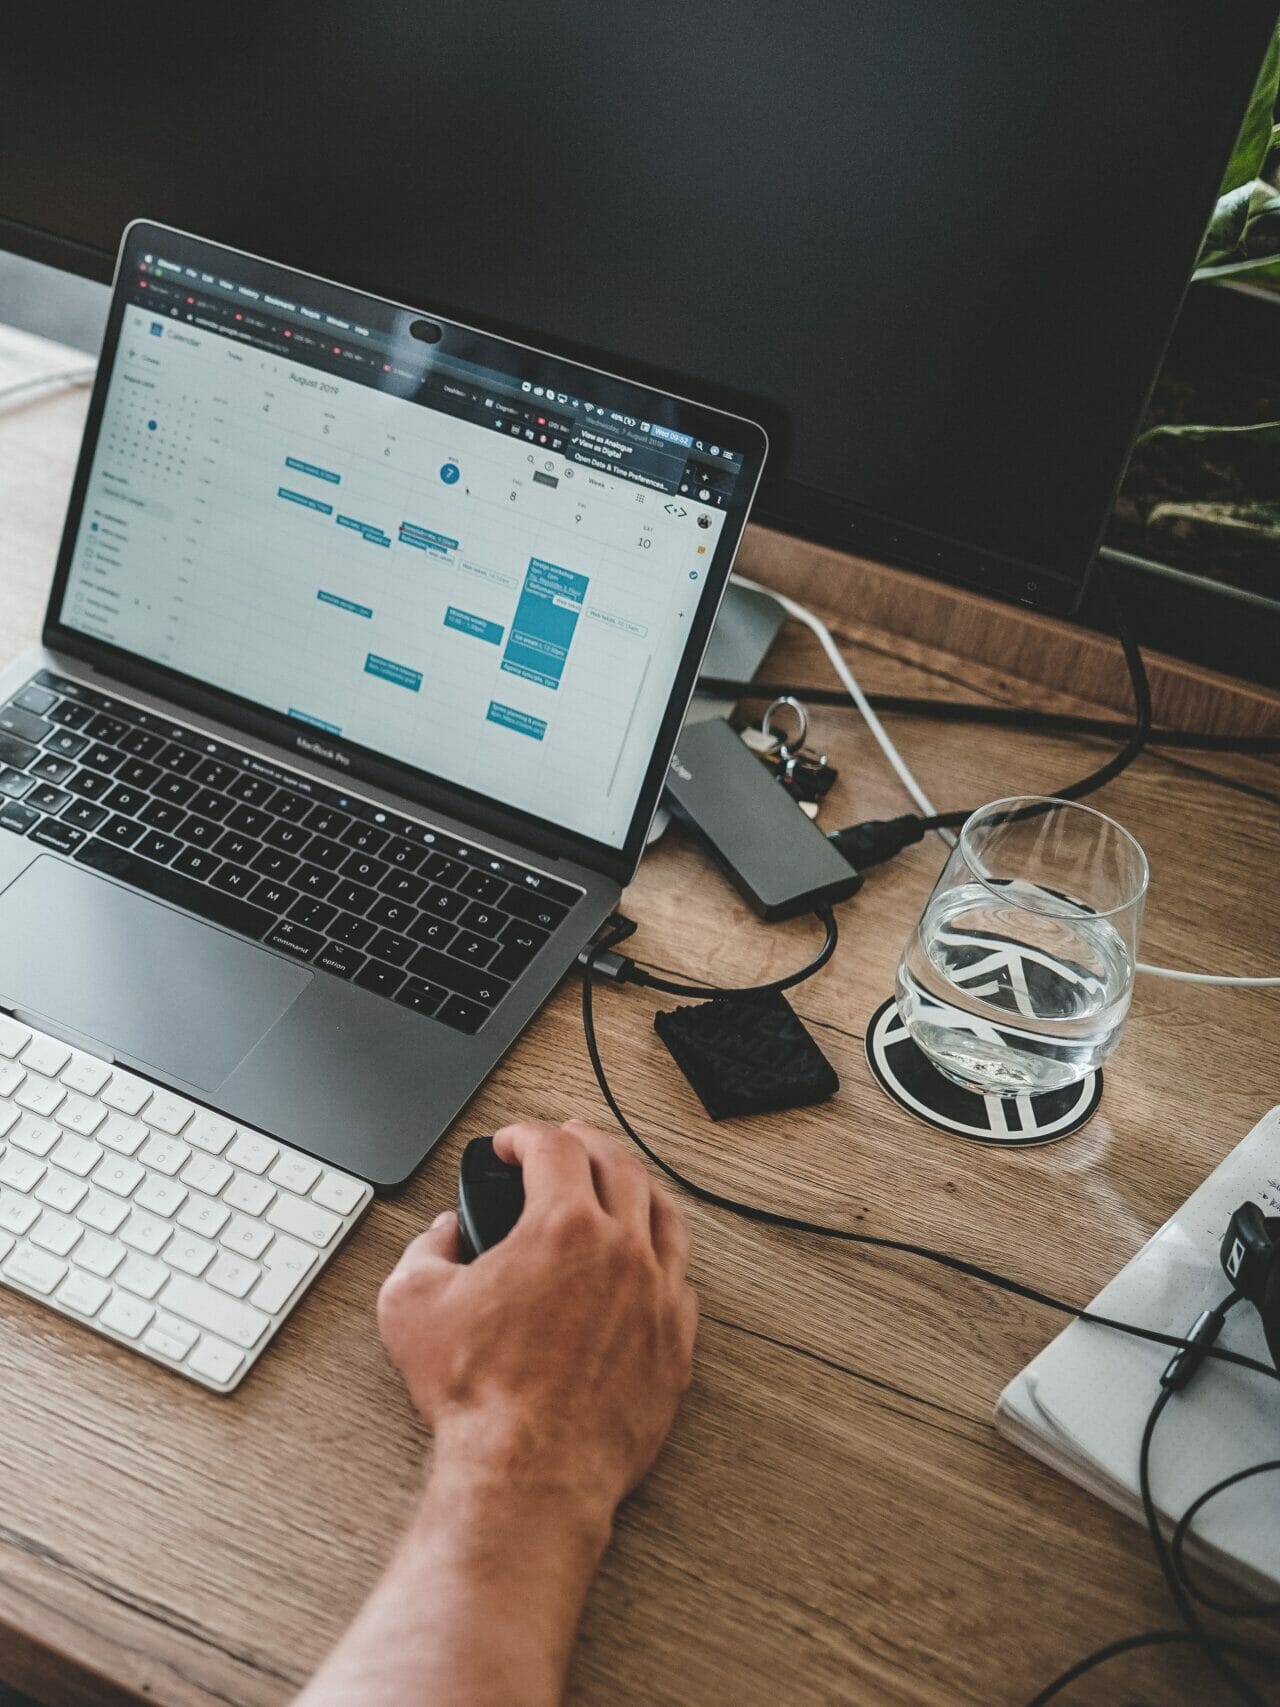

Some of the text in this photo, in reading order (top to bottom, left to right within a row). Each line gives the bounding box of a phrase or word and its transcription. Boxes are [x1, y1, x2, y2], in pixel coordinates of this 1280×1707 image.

[288, 371, 318, 389] August
[654, 426, 670, 438] Wed
[580, 429, 595, 440] View
[604, 437, 633, 455] Analogue
[578, 438, 592, 449] View
[601, 446, 622, 460] Digital
[573, 452, 590, 464] Open
[590, 458, 605, 469] Date
[612, 466, 627, 477] Time
[587, 477, 606, 489] Week
[296, 737, 350, 766] MacBook Pro
[48, 764, 58, 773] A
[132, 769, 143, 778] E
[84, 779, 94, 788] S
[169, 784, 180, 792] R
[120, 795, 130, 803] D
[207, 800, 218, 808] T
[79, 809, 90, 819] X
[157, 811, 168, 819] F
[246, 816, 256, 825] Y
[116, 825, 127, 835] C
[194, 827, 204, 836] G
[282, 832, 293, 841] U
[357, 837, 367, 845] 9
[154, 842, 165, 850] V
[231, 843, 243, 851] H
[396, 853, 405, 861] 0
[191, 858, 202, 867] B
[271, 860, 281, 868] J
[359, 864, 369, 873] O
[229, 874, 241, 884] N
[309, 875, 320, 884] K
[398, 881, 409, 889] P
[267, 890, 281, 902] M
[348, 892, 355, 901] L
[273, 934, 309, 955] command
[322, 957, 346, 972] option
